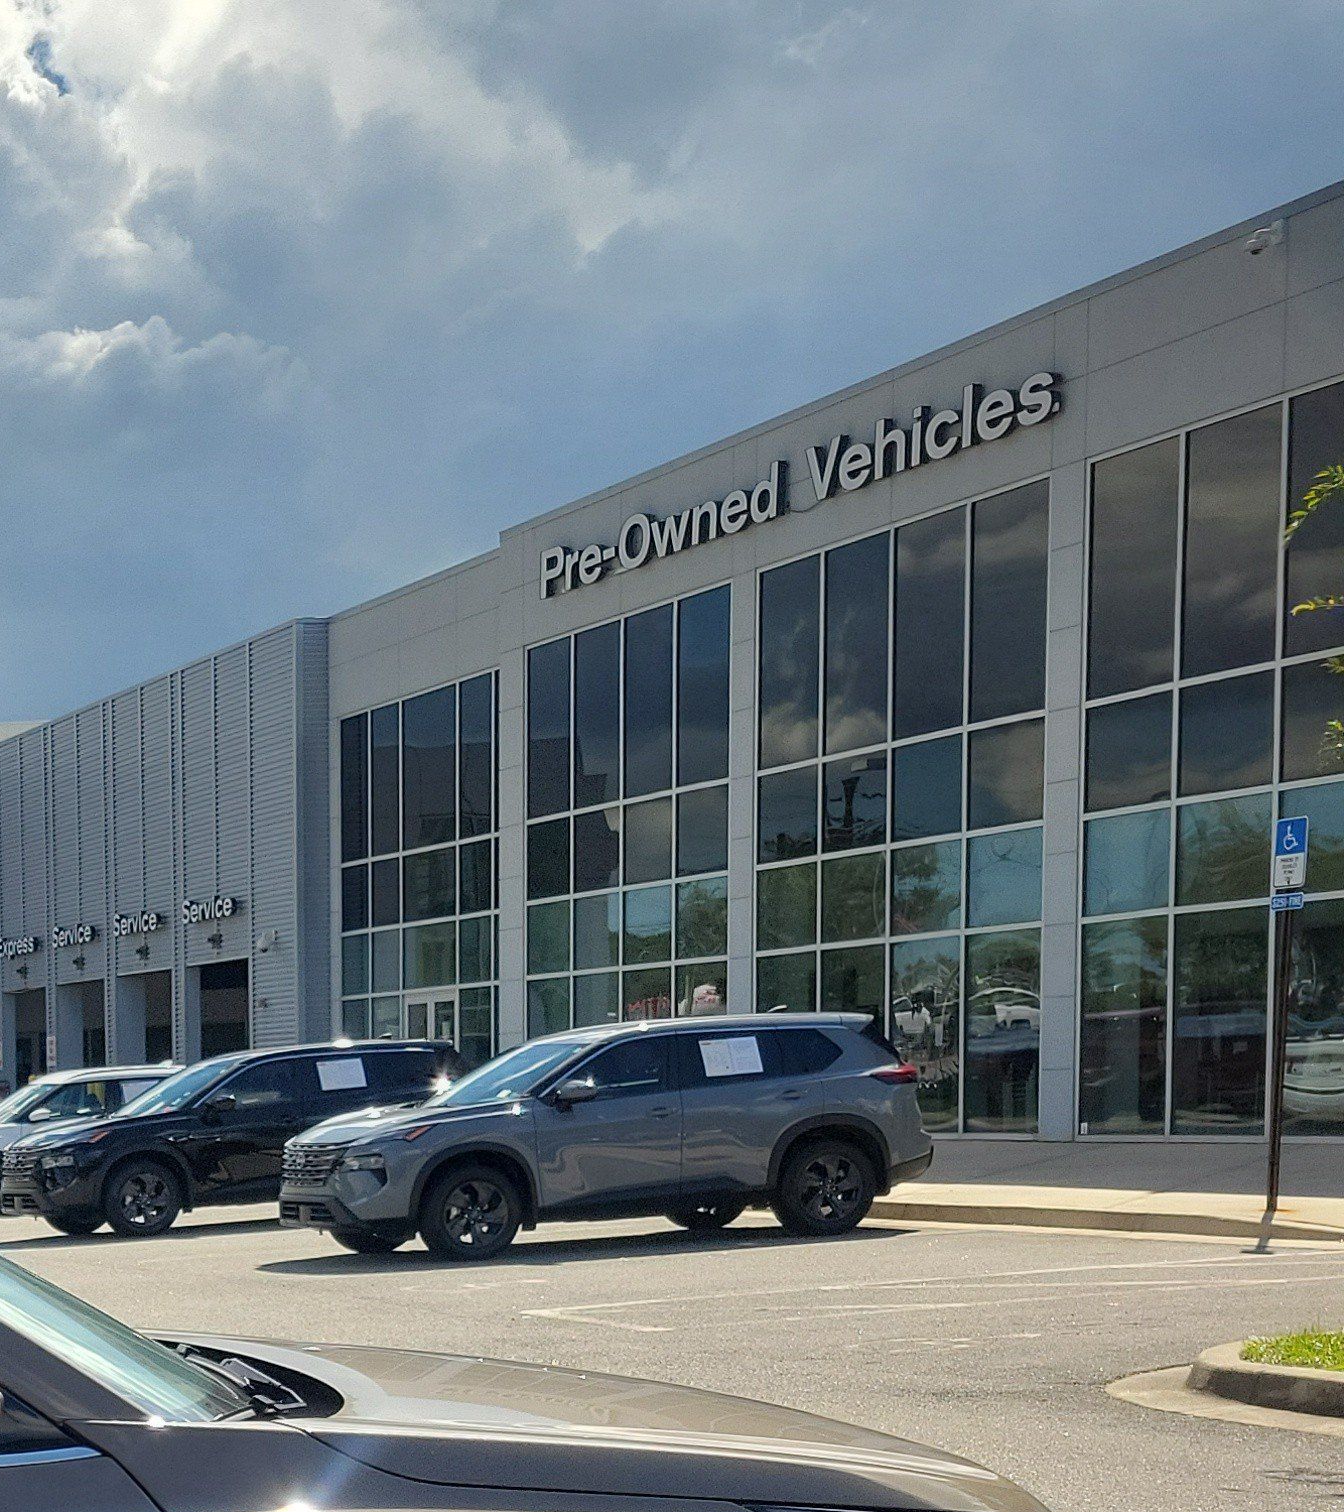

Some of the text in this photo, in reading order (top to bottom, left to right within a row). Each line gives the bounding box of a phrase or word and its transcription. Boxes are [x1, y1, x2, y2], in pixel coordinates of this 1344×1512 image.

[539, 371, 1058, 599] Pre-Owned Vehicles
[181, 896, 233, 924] Service
[52, 925, 92, 949] Service
[113, 912, 157, 936] Service
